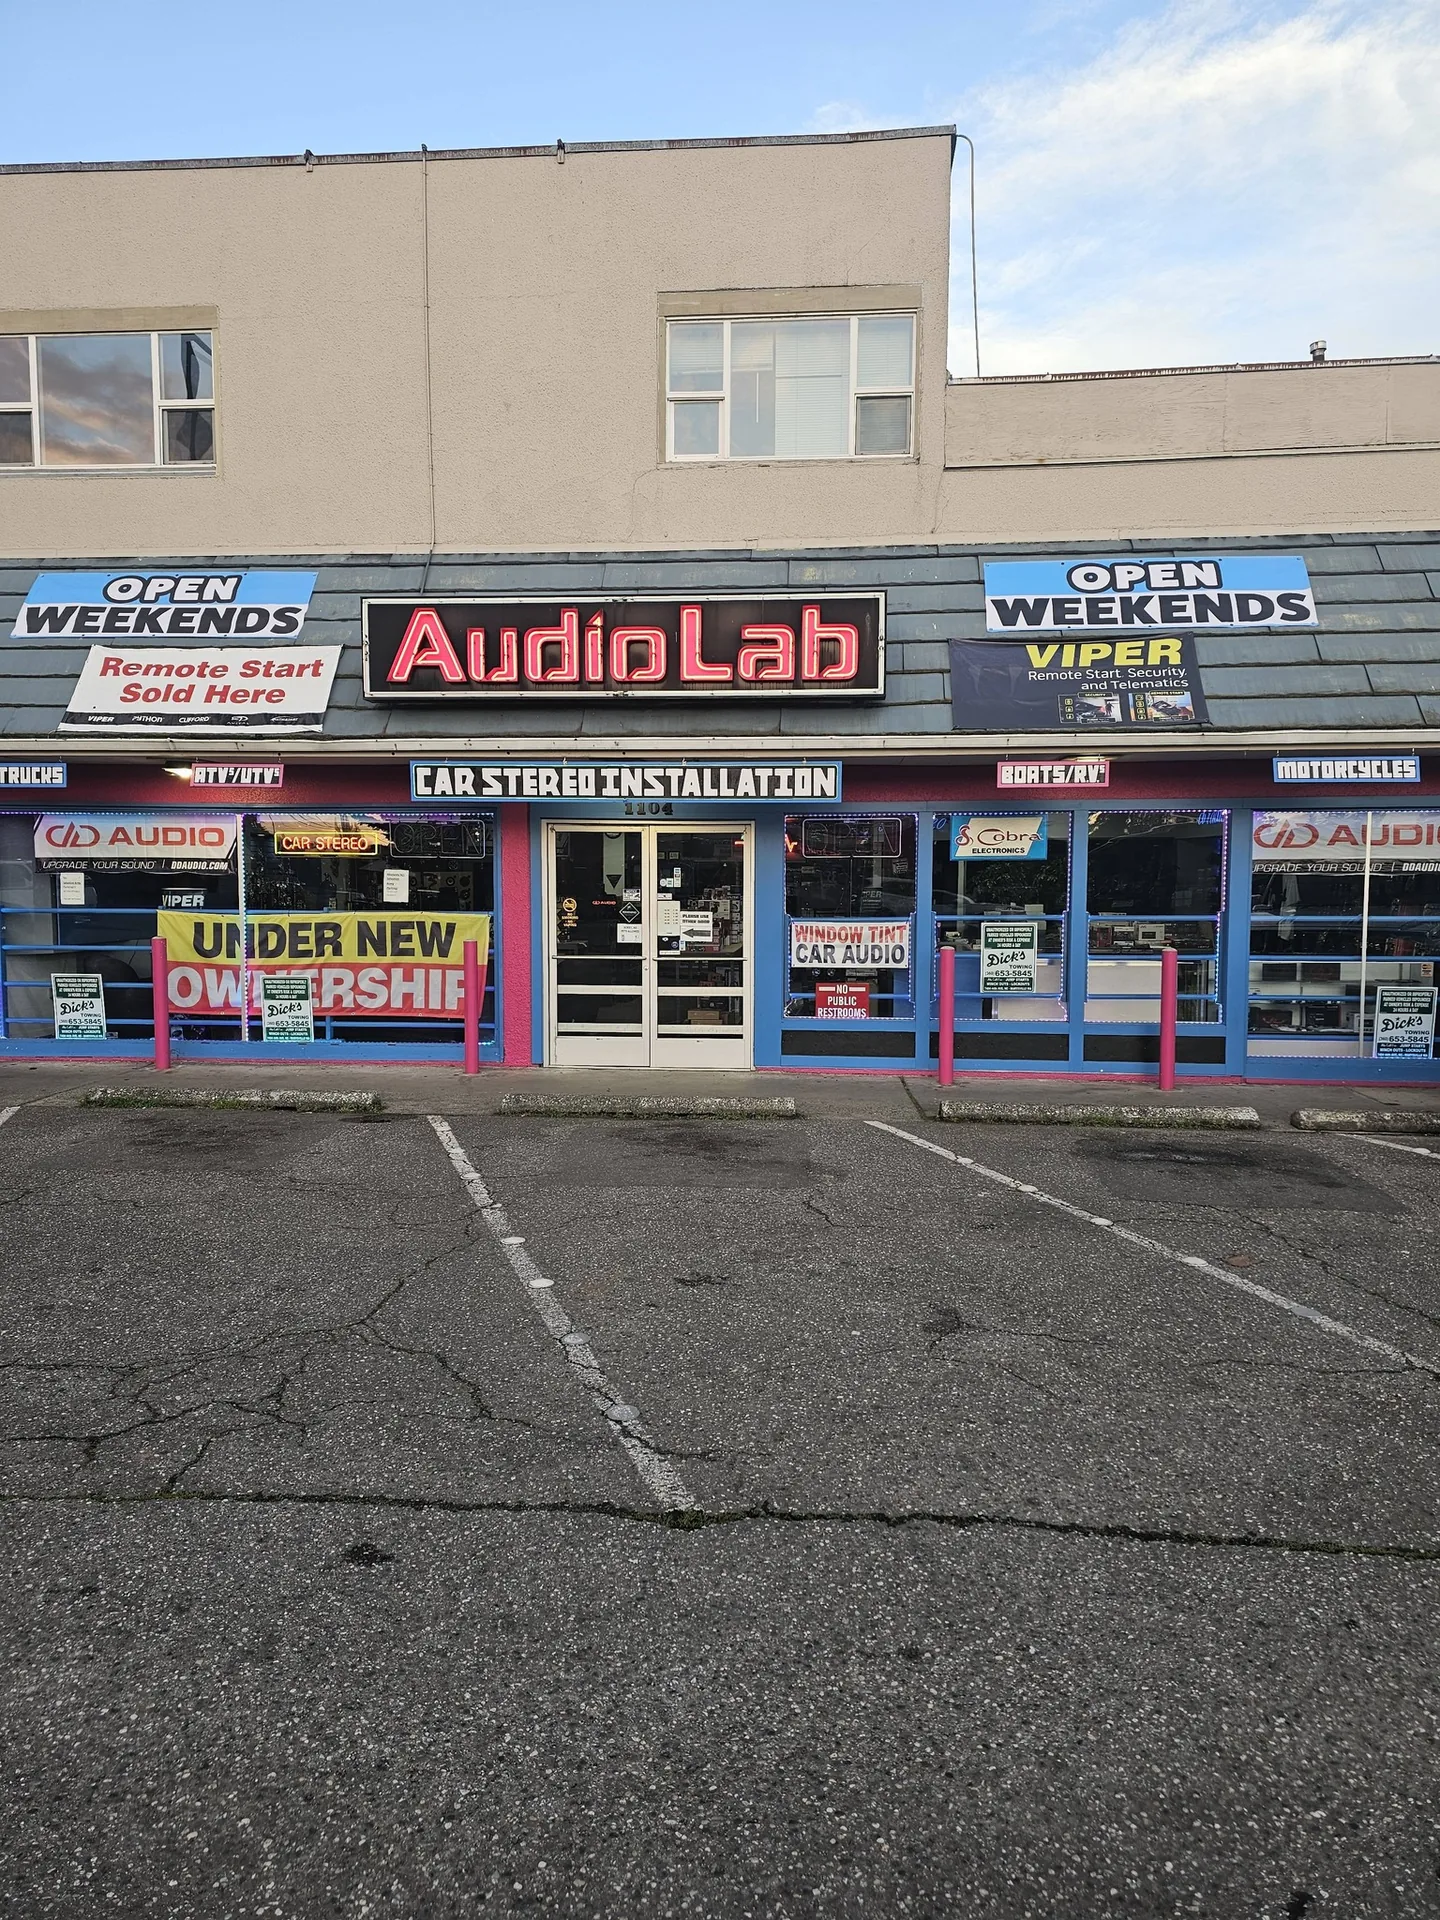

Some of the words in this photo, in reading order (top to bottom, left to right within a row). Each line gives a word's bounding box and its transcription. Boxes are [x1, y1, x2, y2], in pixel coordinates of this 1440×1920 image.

[1067, 561, 1223, 592] OPEN
[104, 576, 242, 603] OPEN
[991, 592, 1311, 627] WEEKENDS
[26, 605, 302, 634] WEEKENDS
[386, 606, 667, 683] Audio
[679, 604, 861, 682] Lab
[1026, 638, 1182, 668] VIPER
[99, 656, 229, 678] Remote
[239, 659, 324, 678] Start
[1028, 670, 1082, 681] Remote
[1081, 681, 1107, 690] and
[1110, 678, 1189, 690] Telematics
[119, 683, 196, 703] Sold
[203, 684, 286, 704] Here
[0, 767, 63, 784] TRUCKS
[1277, 760, 1416, 779] MOTORCYCLES
[416, 767, 476, 795] CAR
[481, 767, 596, 796] STEREO
[601, 768, 836, 797] INSTALLATION
[624, 802, 674, 815] 1104
[108, 827, 225, 846] AUDIO
[282, 836, 311, 850] CAR
[315, 837, 368, 850] STEREO
[977, 828, 1043, 846] Cobra
[1327, 824, 1440, 846] AUDI
[43, 861, 87, 869] UPGRADE
[92, 861, 117, 869] YOUR
[120, 861, 155, 869] SOUND
[170, 861, 228, 871] DDAUDIO.COM
[1307, 862, 1338, 872] YOUR
[1402, 862, 1440, 872] DDAUDI
[162, 894, 204, 907] VIPER
[193, 921, 343, 959] UNDER
[357, 920, 456, 958] NEW
[794, 924, 863, 943] WINDOW
[868, 925, 906, 943] TINT
[795, 944, 836, 964] CAR
[842, 944, 905, 964] AUDIO
[986, 951, 1026, 967] Dick's
[836, 984, 848, 994] NO
[60, 1000, 94, 1015] Dick's
[267, 1002, 302, 1017] Dick's
[827, 996, 857, 1006] PUBLIC
[817, 1007, 867, 1018] RESTROOMS
[1381, 1016, 1423, 1032] Dick's
